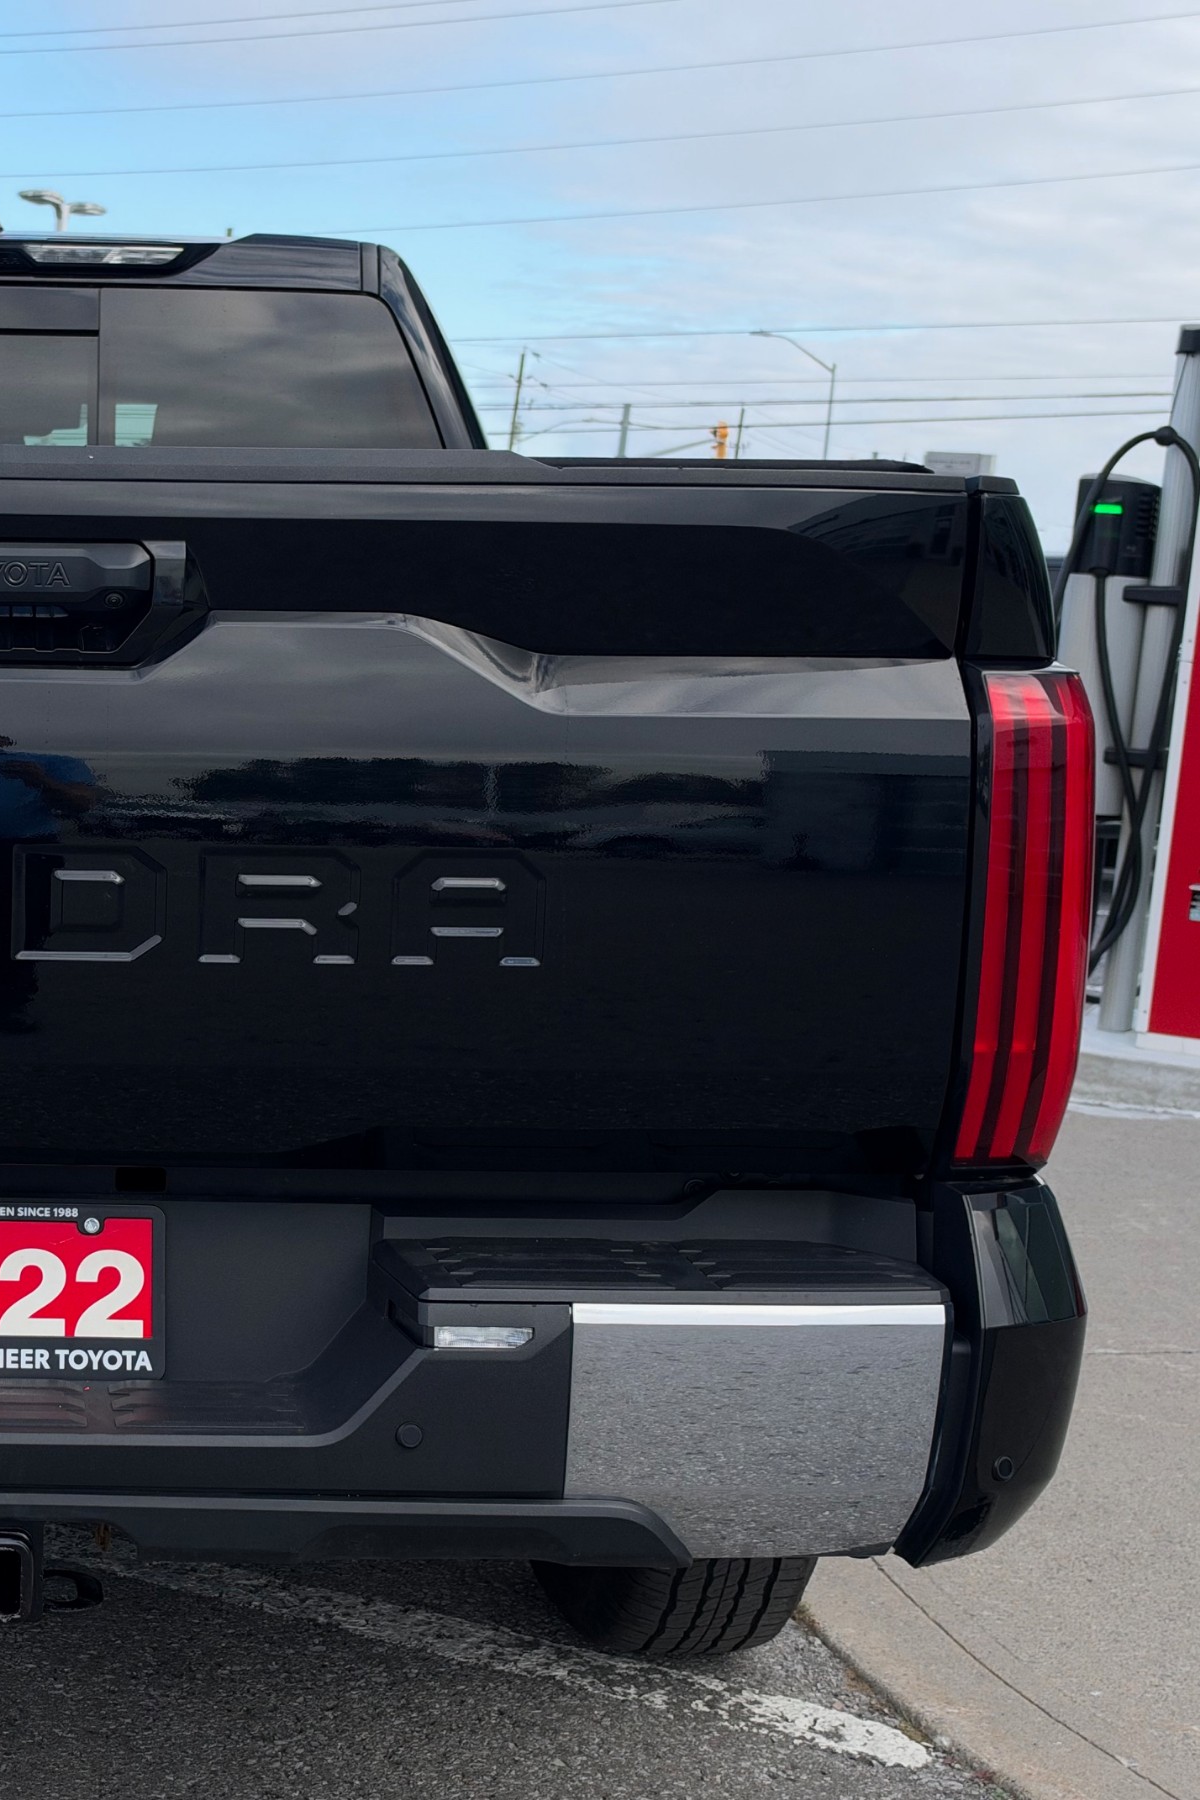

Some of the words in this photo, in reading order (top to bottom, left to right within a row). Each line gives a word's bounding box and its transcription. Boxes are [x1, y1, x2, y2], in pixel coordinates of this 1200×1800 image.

[17, 1207, 51, 1218] SINCE
[52, 1207, 79, 1218] 1988
[54, 1349, 153, 1371] TOYOTA
